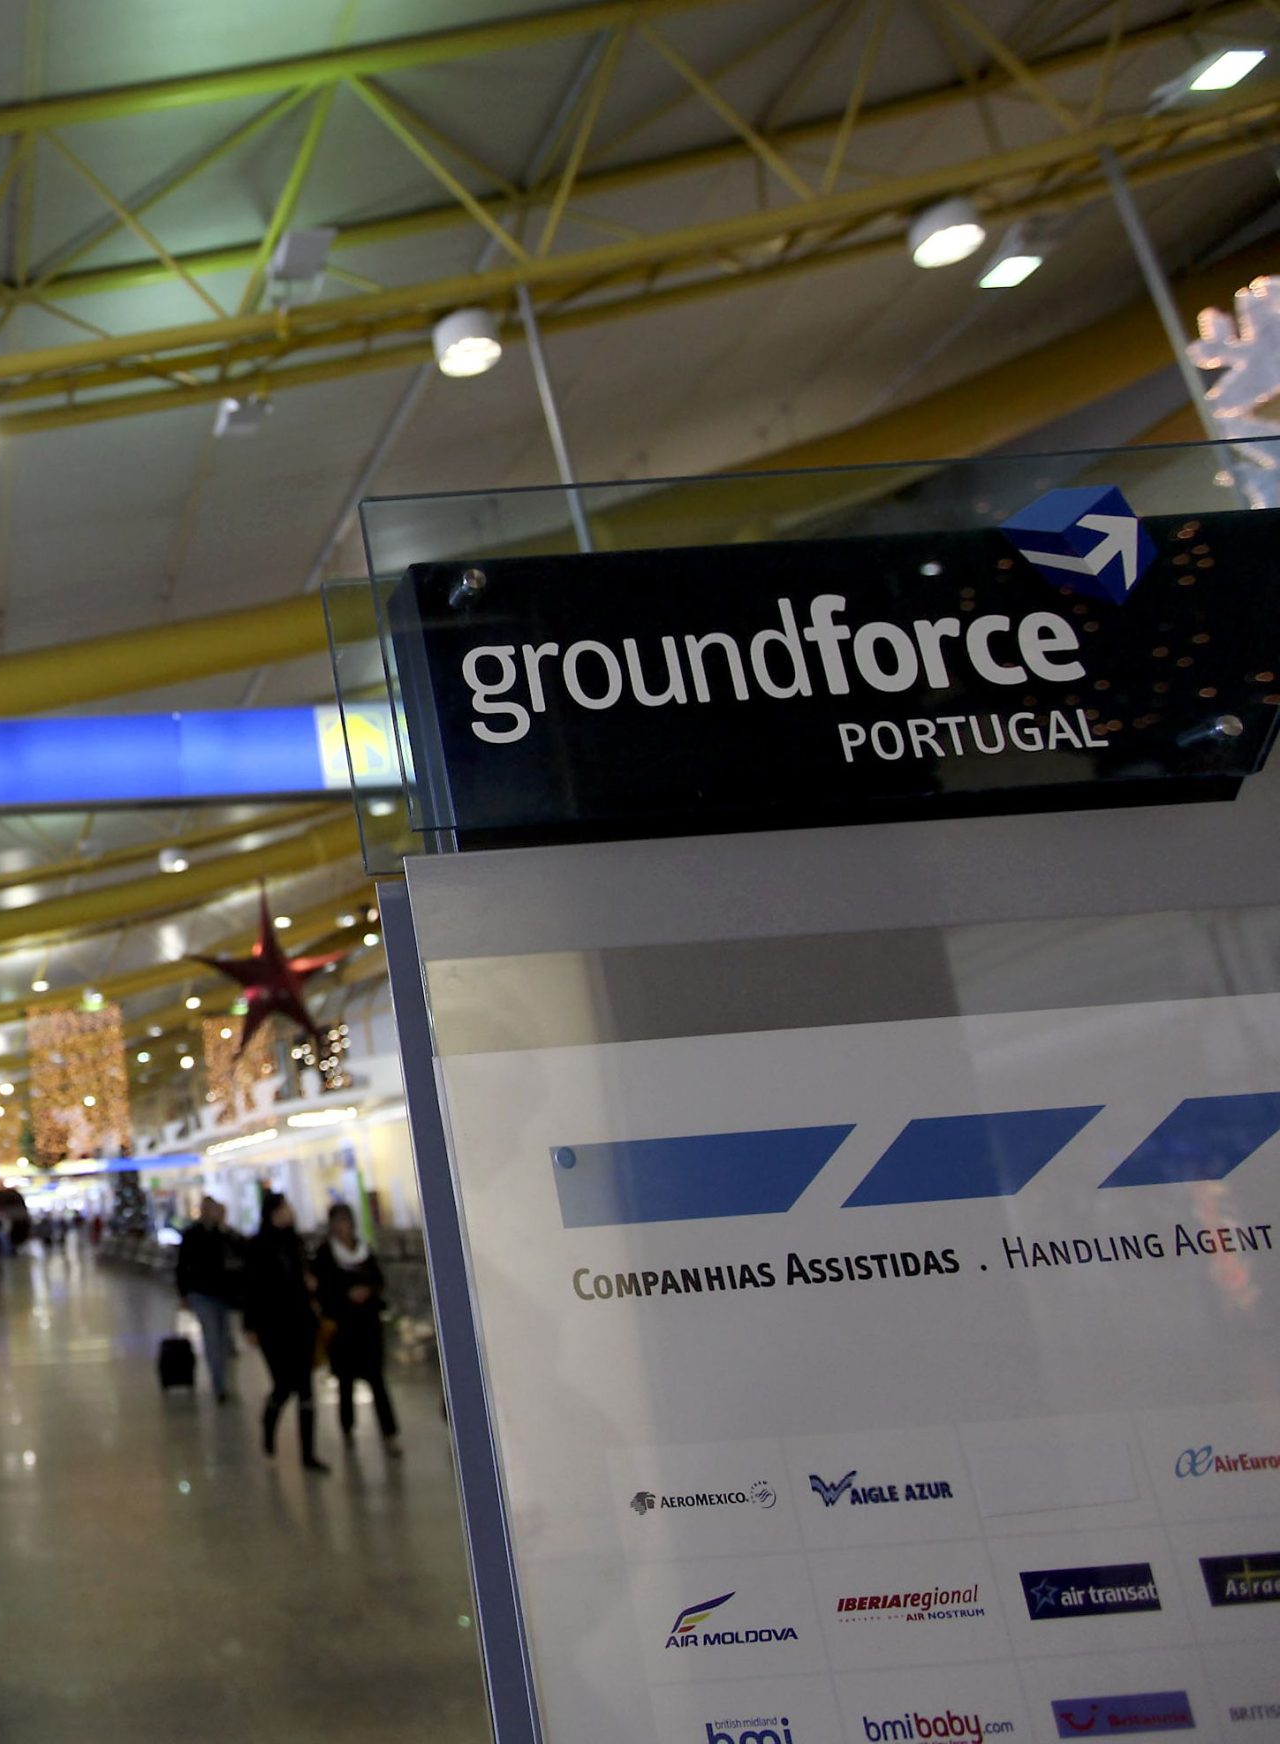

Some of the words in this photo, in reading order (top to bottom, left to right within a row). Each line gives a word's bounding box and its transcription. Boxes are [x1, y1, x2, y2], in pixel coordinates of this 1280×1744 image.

[462, 594, 1086, 744] groundforce
[838, 709, 1109, 763] PORTUGAL
[572, 1261, 776, 1301] COMPANHIAS
[785, 1247, 961, 1286] ASSISTIDAS
[1002, 1231, 1165, 1270] HANDLING
[1174, 1223, 1274, 1258] AGENT
[1215, 1453, 1280, 1473] AirEuro
[849, 1485, 900, 1505] AIGLE
[905, 1481, 954, 1501] AZUR
[1060, 1586, 1085, 1606] air
[1088, 1582, 1158, 1604] transat
[906, 1612, 925, 1622] AIR
[927, 1608, 985, 1620] NOSTRUM
[665, 1633, 698, 1649] AIR
[703, 1627, 799, 1647] MOLDOVA
[714, 1719, 741, 1729] british
[743, 1717, 777, 1728] midland
